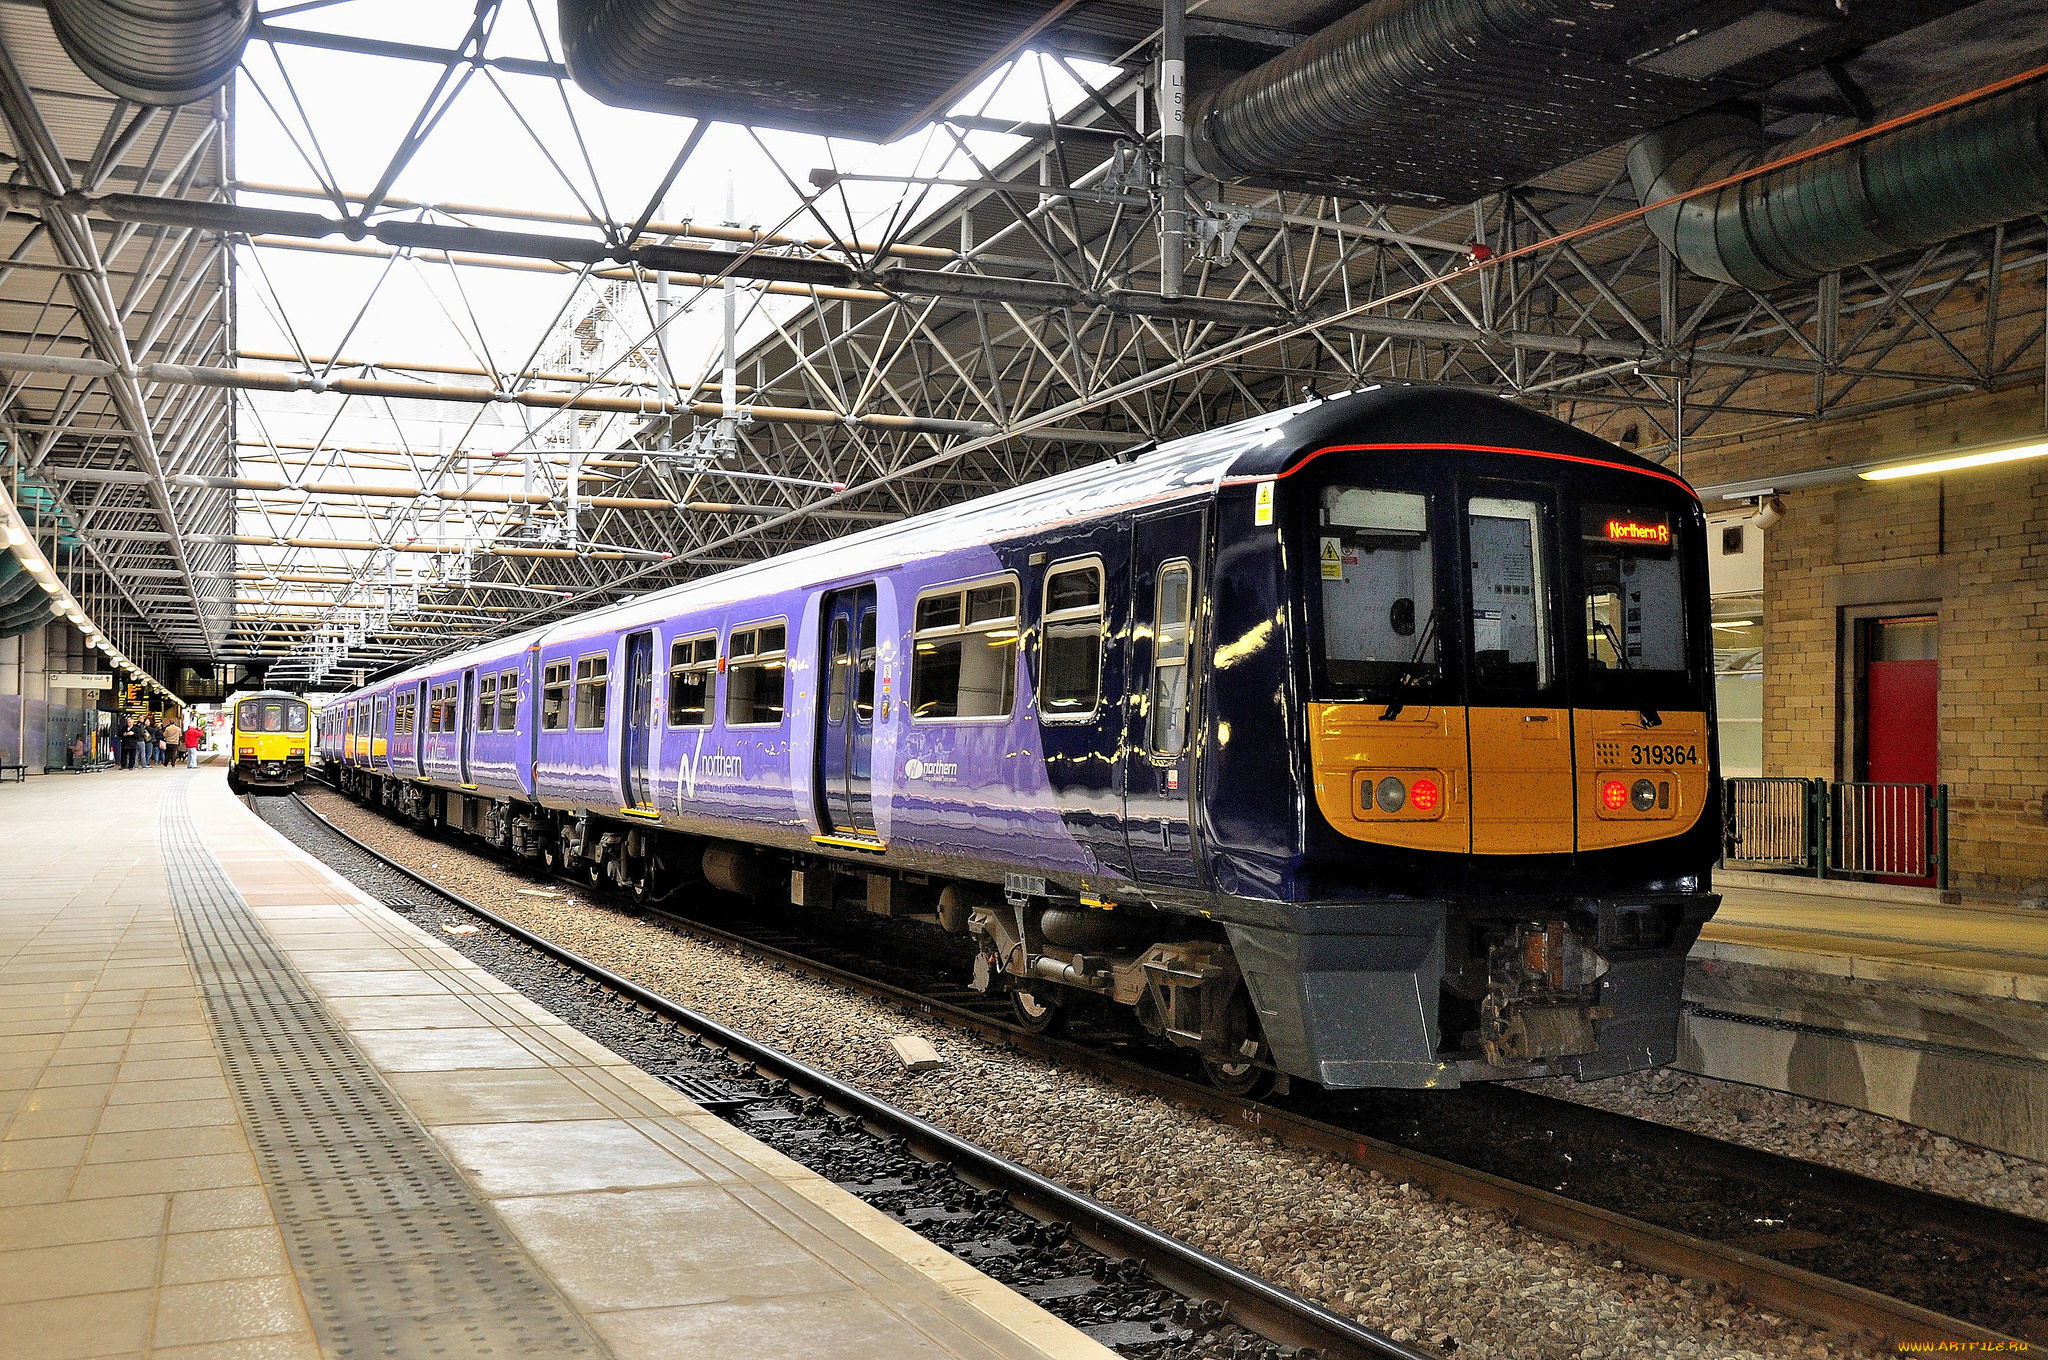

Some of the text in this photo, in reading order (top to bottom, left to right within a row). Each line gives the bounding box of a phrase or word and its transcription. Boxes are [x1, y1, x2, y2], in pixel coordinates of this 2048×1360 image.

[1609, 521, 1657, 539] Northern
[702, 743, 742, 778] northern
[1631, 744, 1697, 765] 319364
[923, 759, 957, 775] northern
